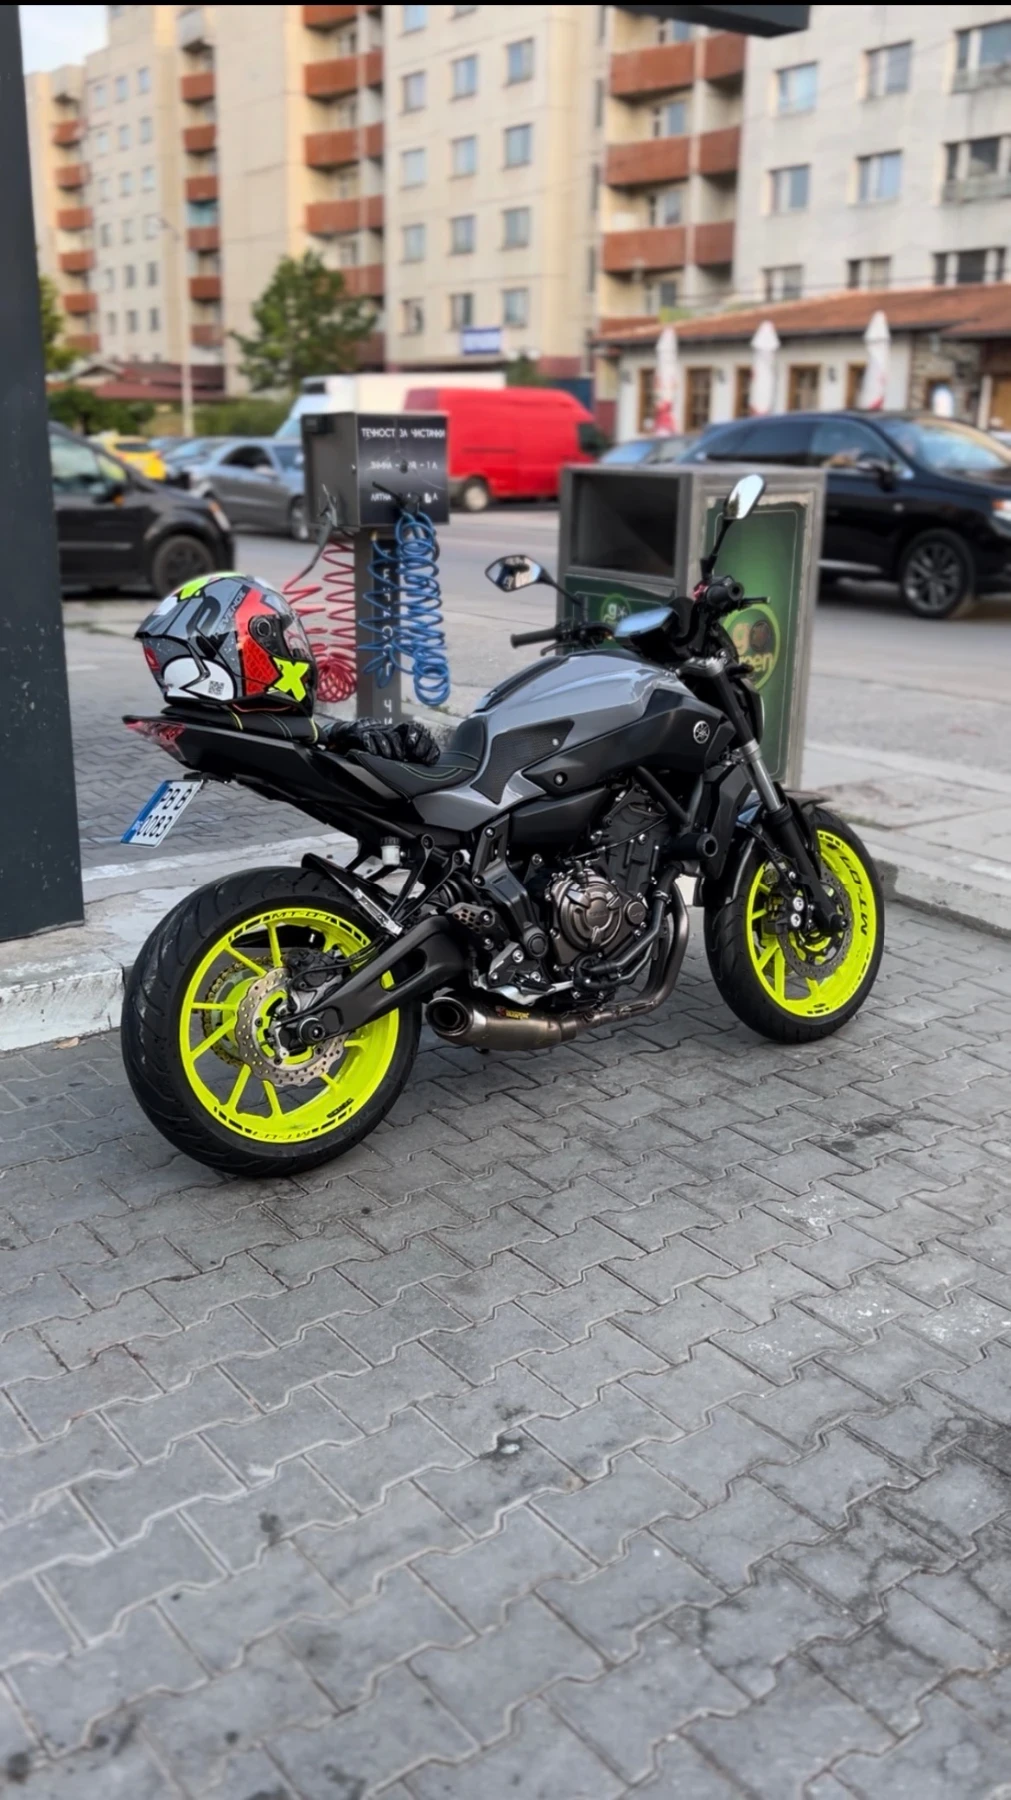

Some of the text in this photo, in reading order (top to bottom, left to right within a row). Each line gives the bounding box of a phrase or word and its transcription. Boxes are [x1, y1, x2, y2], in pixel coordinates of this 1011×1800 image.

[361, 428, 395, 438] ТЕЧНОСТ
[399, 429, 408, 438] ЗА
[213, 591, 247, 639] REVENGE
[136, 814, 173, 838] 0083
[839, 856, 869, 936] MT-07
